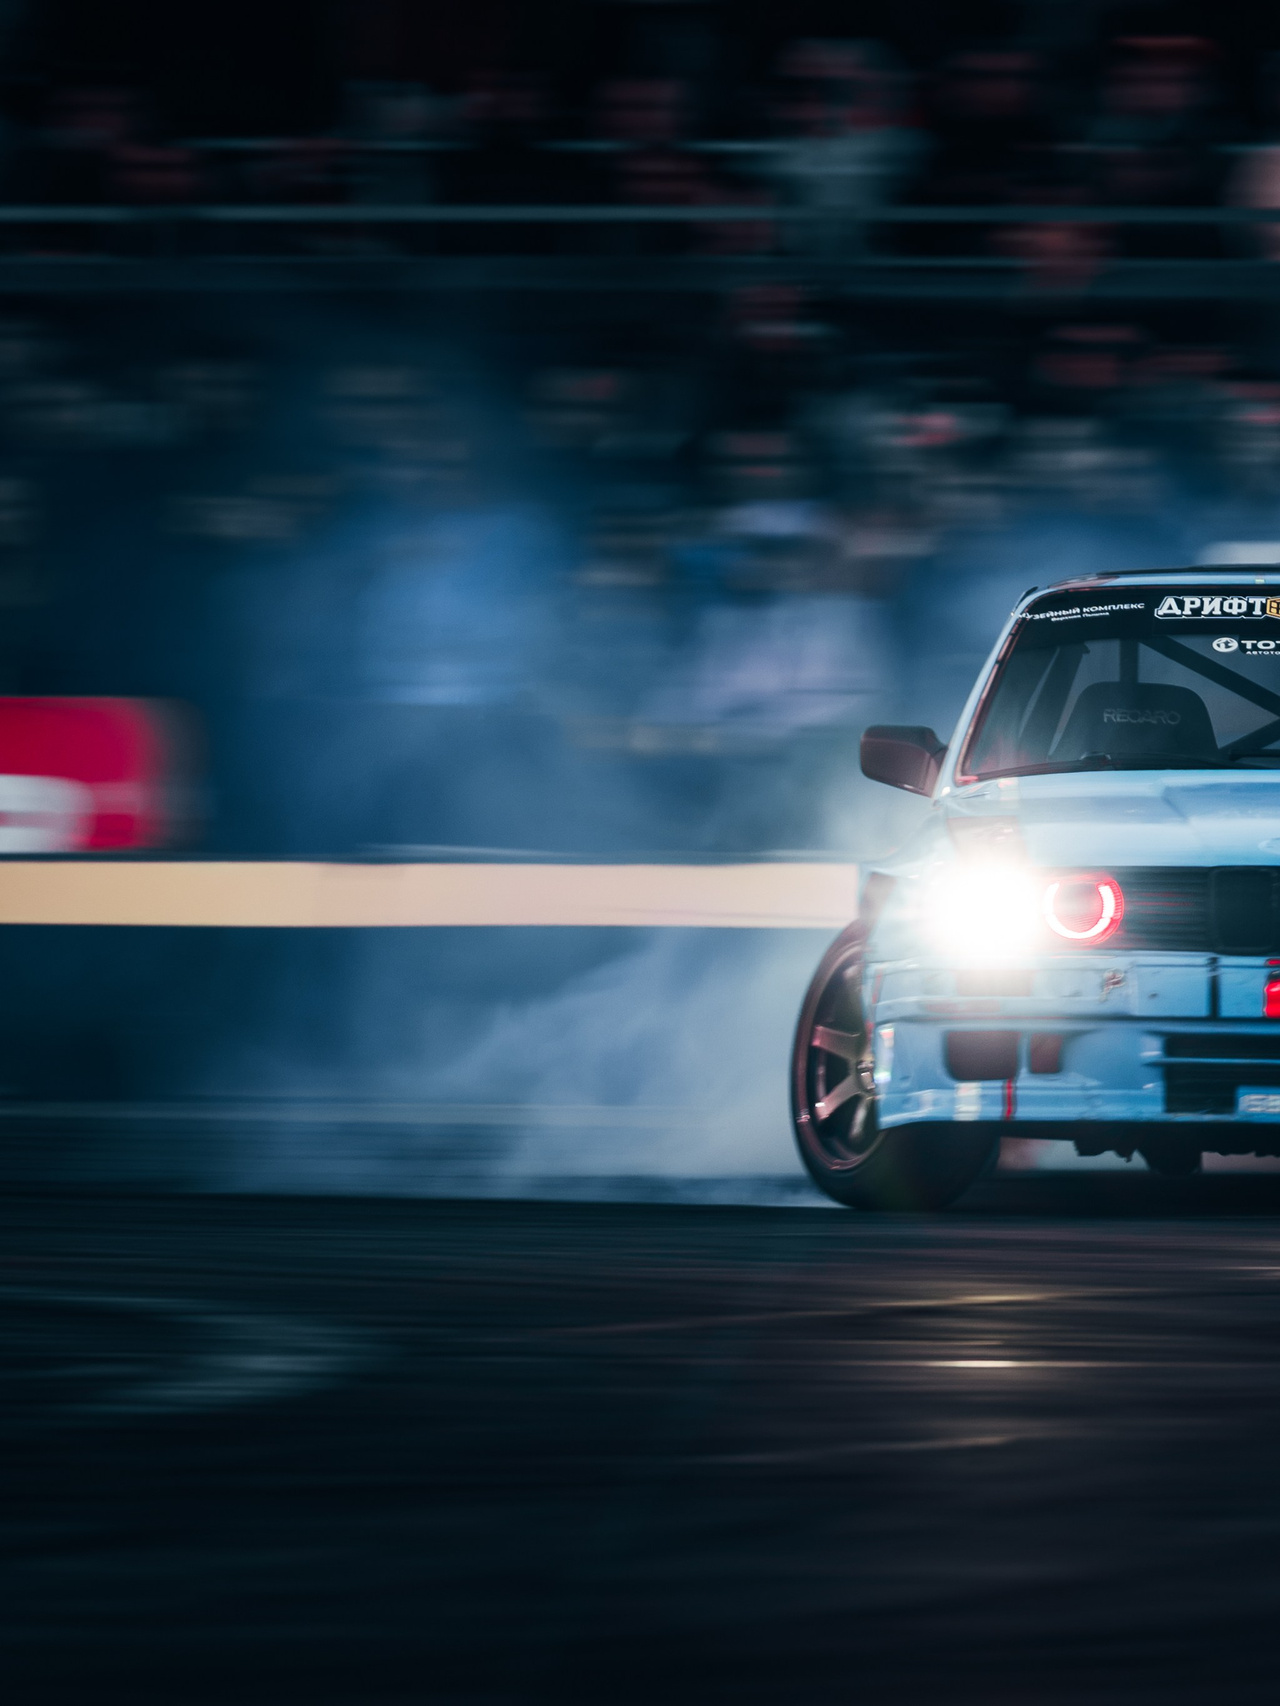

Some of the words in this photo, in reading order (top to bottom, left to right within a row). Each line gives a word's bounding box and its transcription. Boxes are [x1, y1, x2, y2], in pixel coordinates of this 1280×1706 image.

[1082, 602, 1146, 613] КОМПЛЕКС
[1156, 596, 1267, 618] ДРИФТ
[1102, 707, 1181, 725] RECARO
